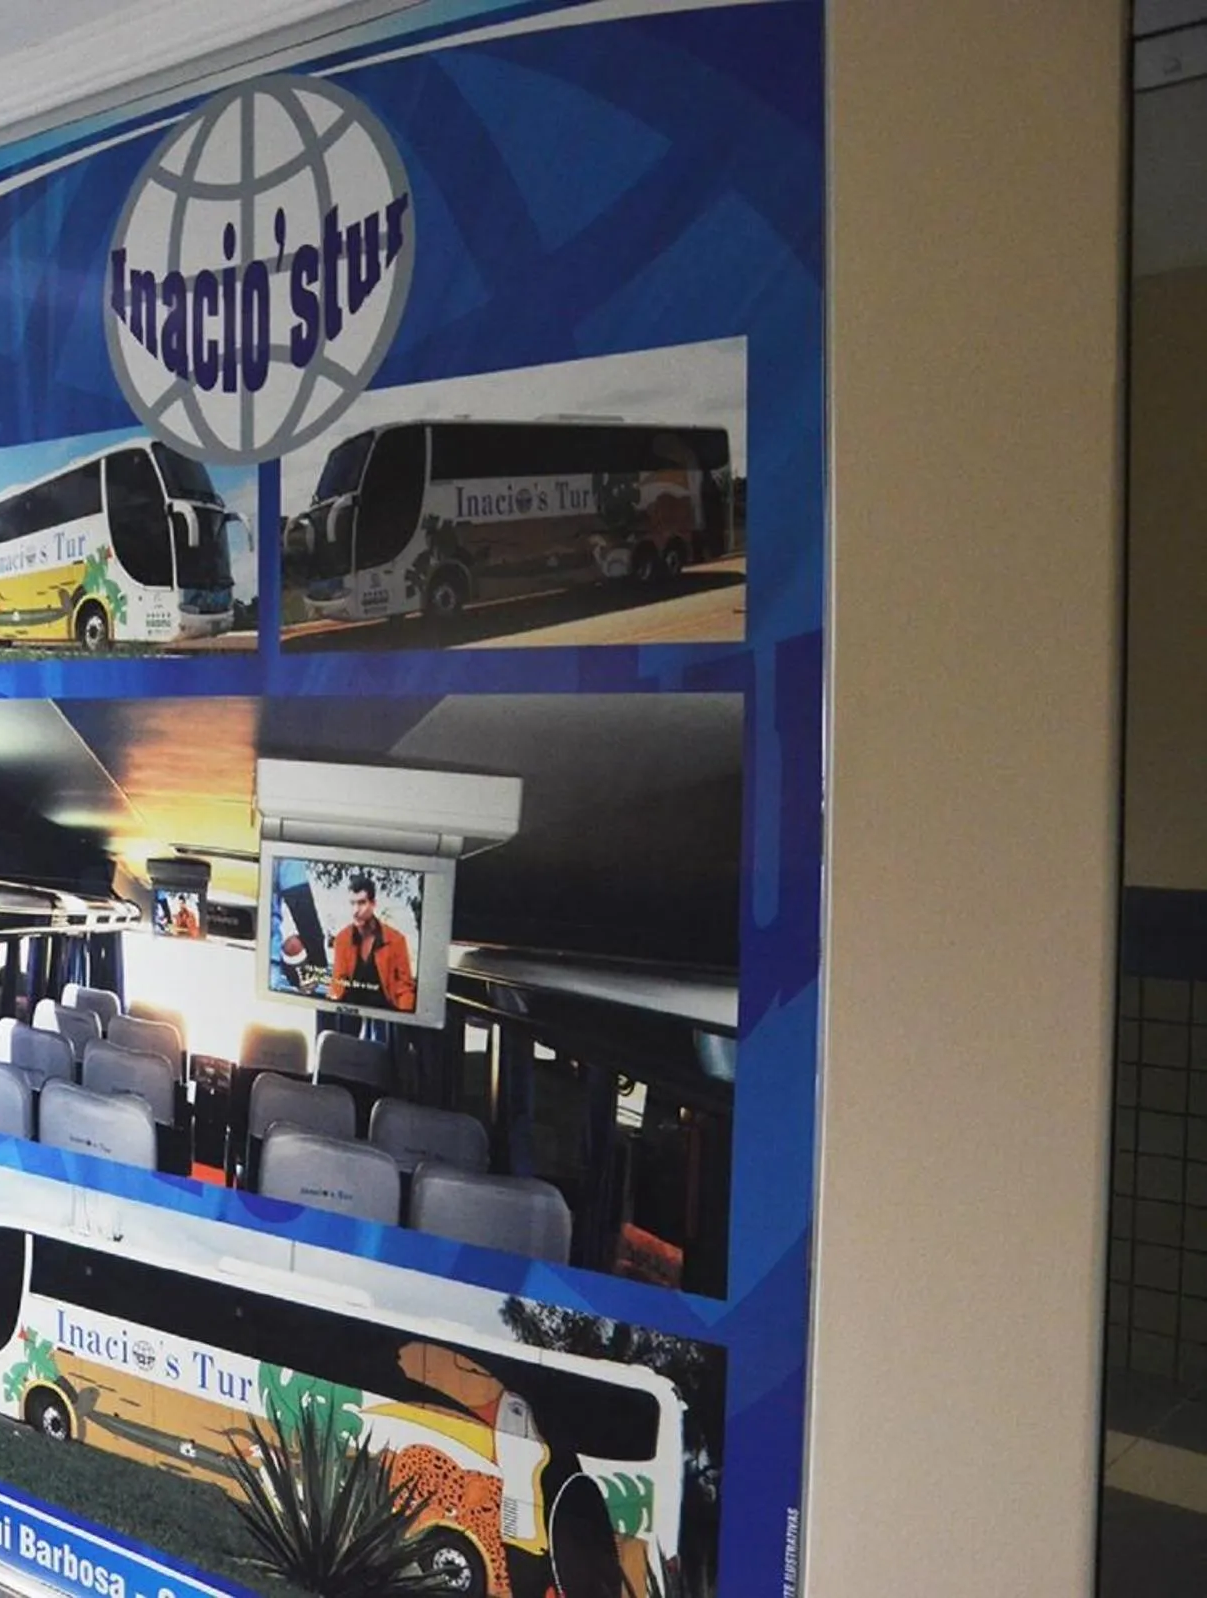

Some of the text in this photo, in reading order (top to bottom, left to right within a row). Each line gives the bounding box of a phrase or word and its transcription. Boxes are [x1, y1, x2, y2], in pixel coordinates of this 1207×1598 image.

[555, 481, 590, 510] Tur
[55, 532, 86, 561] Tur
[193, 1351, 253, 1401] Tur
[19, 1524, 125, 1598] Barbosa
